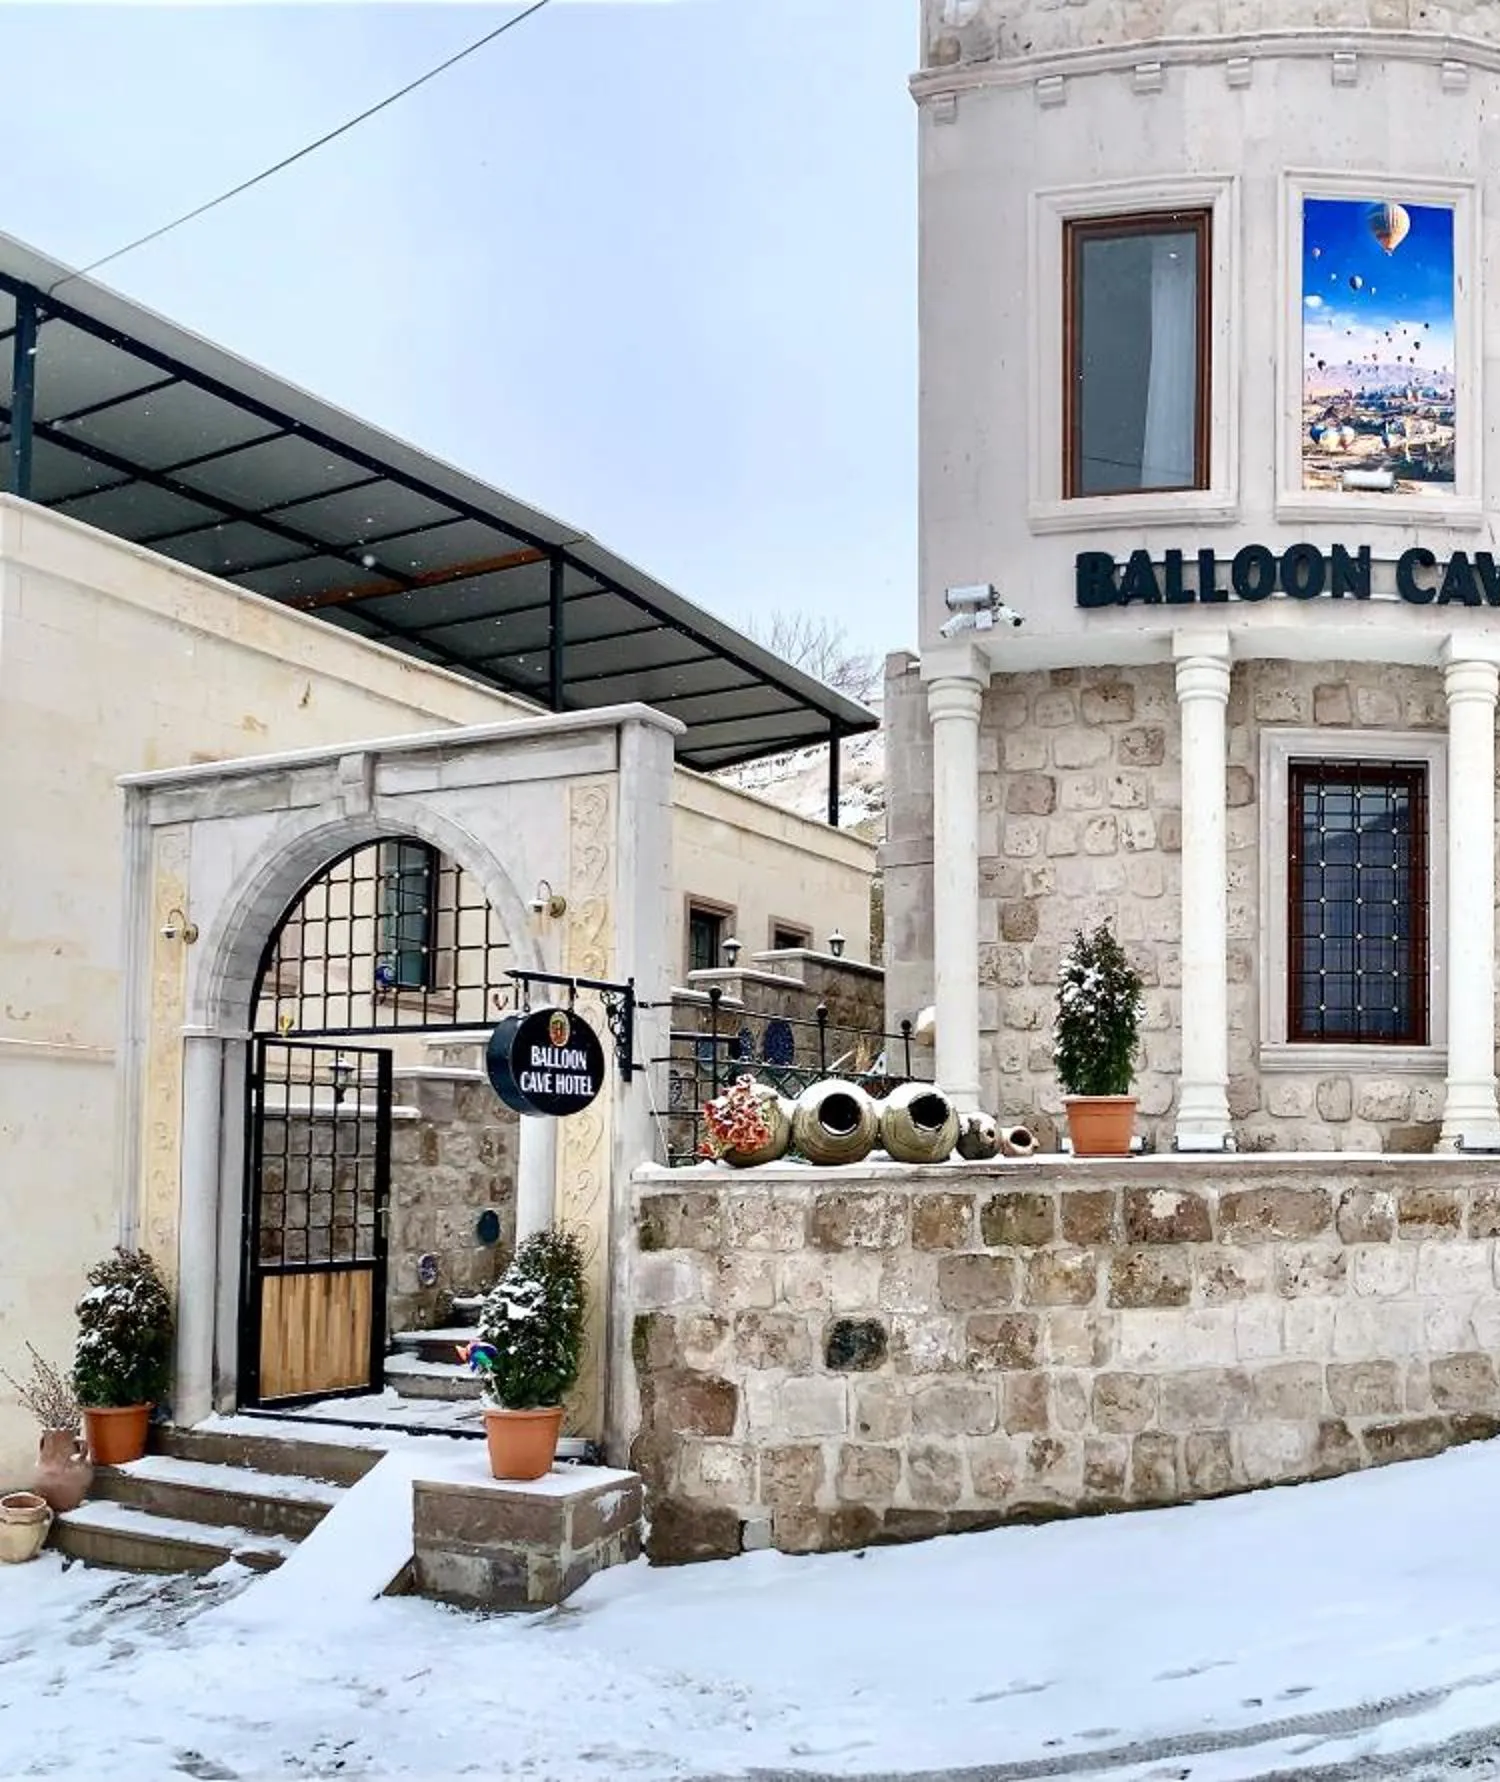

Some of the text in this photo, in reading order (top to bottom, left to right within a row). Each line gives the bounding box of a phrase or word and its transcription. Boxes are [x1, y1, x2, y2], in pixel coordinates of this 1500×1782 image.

[1076, 543, 1371, 608] BALLOON
[531, 1045, 587, 1071] BALLOON
[520, 1071, 595, 1096] CAVE HOTEL
